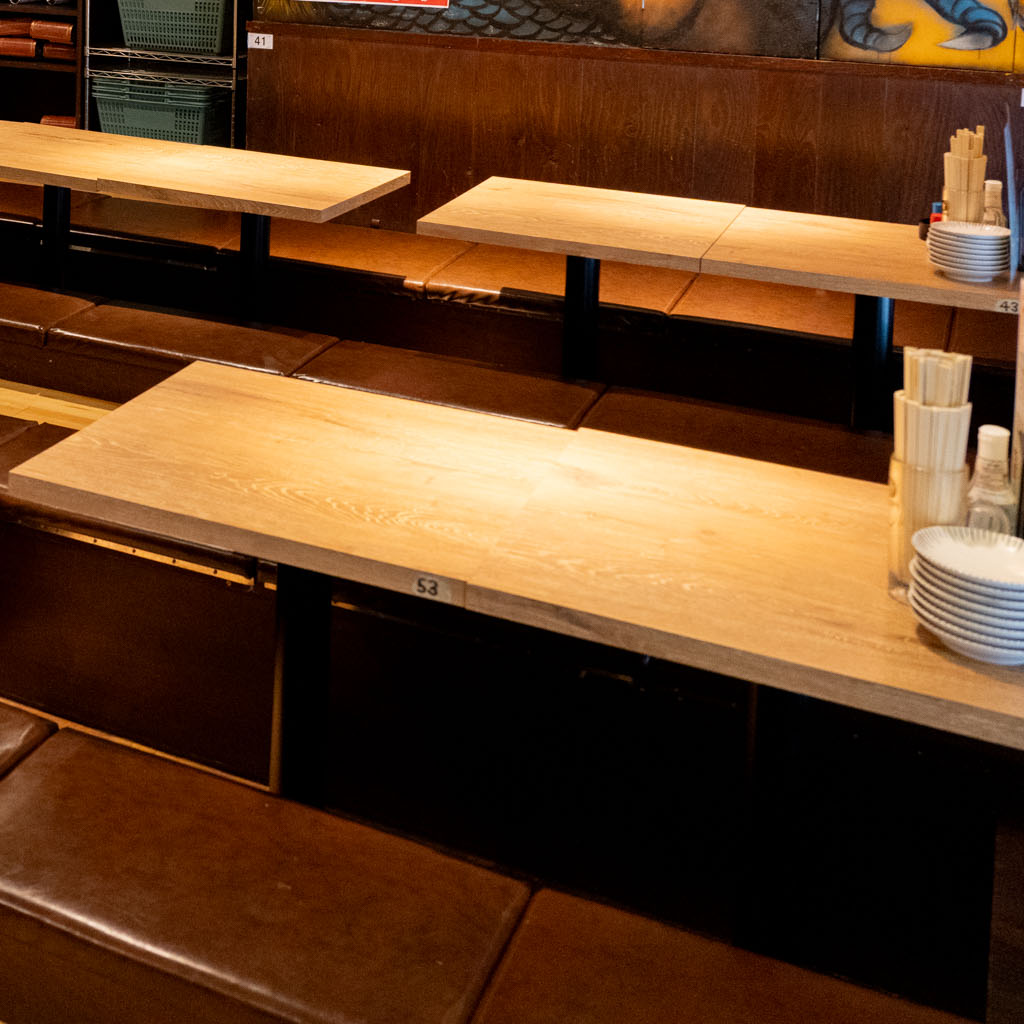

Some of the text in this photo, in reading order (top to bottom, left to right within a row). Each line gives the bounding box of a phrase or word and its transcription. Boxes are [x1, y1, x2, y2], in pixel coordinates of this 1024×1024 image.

[254, 36, 266, 46] 41
[999, 301, 1019, 313] 43
[416, 577, 439, 596] 53
